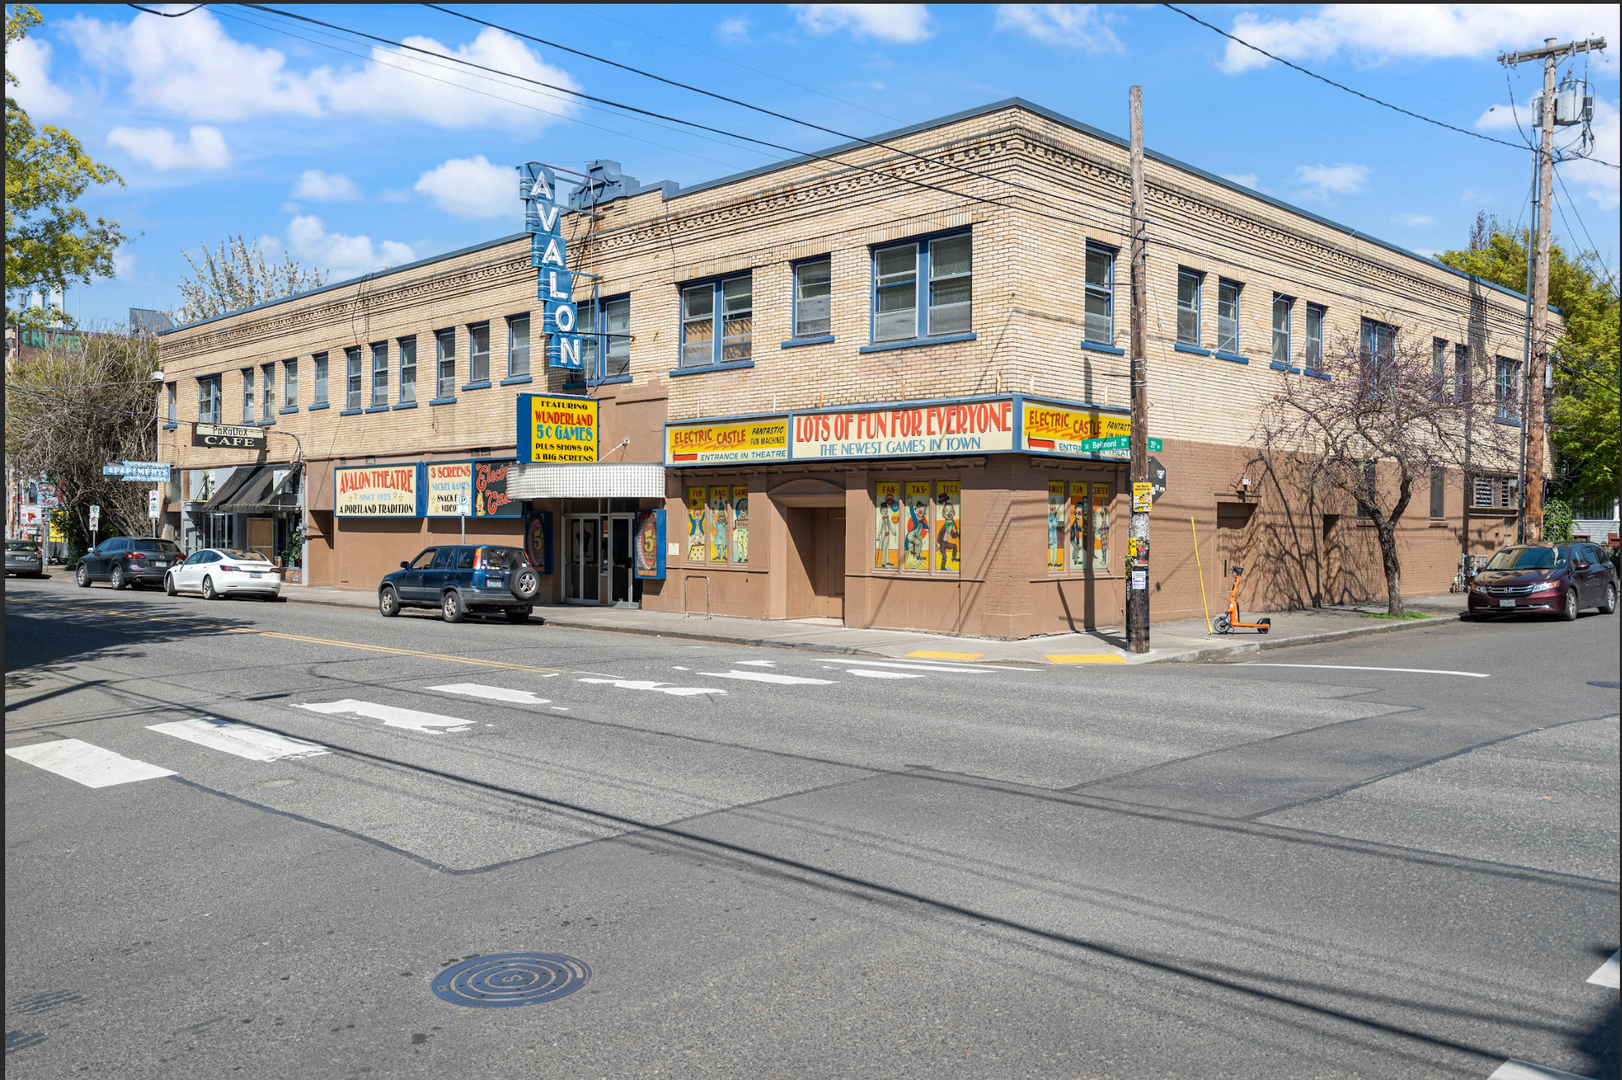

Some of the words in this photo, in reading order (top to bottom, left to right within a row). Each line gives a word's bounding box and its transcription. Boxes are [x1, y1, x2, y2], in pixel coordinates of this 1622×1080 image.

[530, 170, 581, 366] AVALON
[541, 401, 588, 410] FEATURING
[535, 410, 594, 427] WUNDERLAND
[796, 415, 831, 443] LOTS
[834, 413, 854, 441] OF
[857, 411, 887, 440] FUN
[890, 409, 922, 438] FOR
[926, 402, 1012, 436] EVERYONE
[1029, 410, 1070, 428] ELECTRIC
[1073, 419, 1102, 435] CASTLE
[751, 426, 784, 436] FANTASTIC
[1106, 421, 1131, 431] FANTAST
[555, 425, 593, 442] GAMES
[674, 428, 713, 444] ELECTRIC
[716, 429, 747, 445] CASTLE
[204, 435, 255, 447] CAFE
[750, 437, 760, 446] FUN
[760, 436, 785, 445] MACHINES
[535, 443, 555, 451] PLUS
[556, 444, 582, 452] SHOWS
[819, 443, 838, 457] THE
[841, 441, 882, 455] NEWEST
[885, 439, 926, 454] GAMES
[929, 438, 942, 452] IN
[945, 437, 981, 451] TOWN
[542, 453, 557, 461] BIG
[558, 454, 594, 462] SCREENS
[700, 452, 739, 462] ENTRANCE
[740, 451, 749, 460] IN
[751, 450, 786, 460] THEATRE
[430, 467, 436, 479] 3
[437, 465, 471, 479] SCREENS
[340, 471, 371, 495] AVALON
[371, 469, 414, 493] THEATRE
[431, 481, 451, 492] NICKEL
[451, 480, 470, 491] GAMES
[692, 489, 703, 497] FUN
[714, 489, 727, 497] AND
[734, 488, 748, 497] GAME
[882, 485, 898, 494] FAN-
[912, 485, 928, 494] TAS-
[942, 484, 958, 493] TIC!
[1073, 486, 1083, 494] FUN
[359, 493, 376, 502] SINCE
[376, 492, 391, 501] 1925
[437, 494, 454, 503] SNACK
[339, 504, 343, 514] A
[344, 504, 377, 514] PORTLAND
[378, 503, 414, 514] TRADITION
[441, 504, 457, 513] VIDEO
